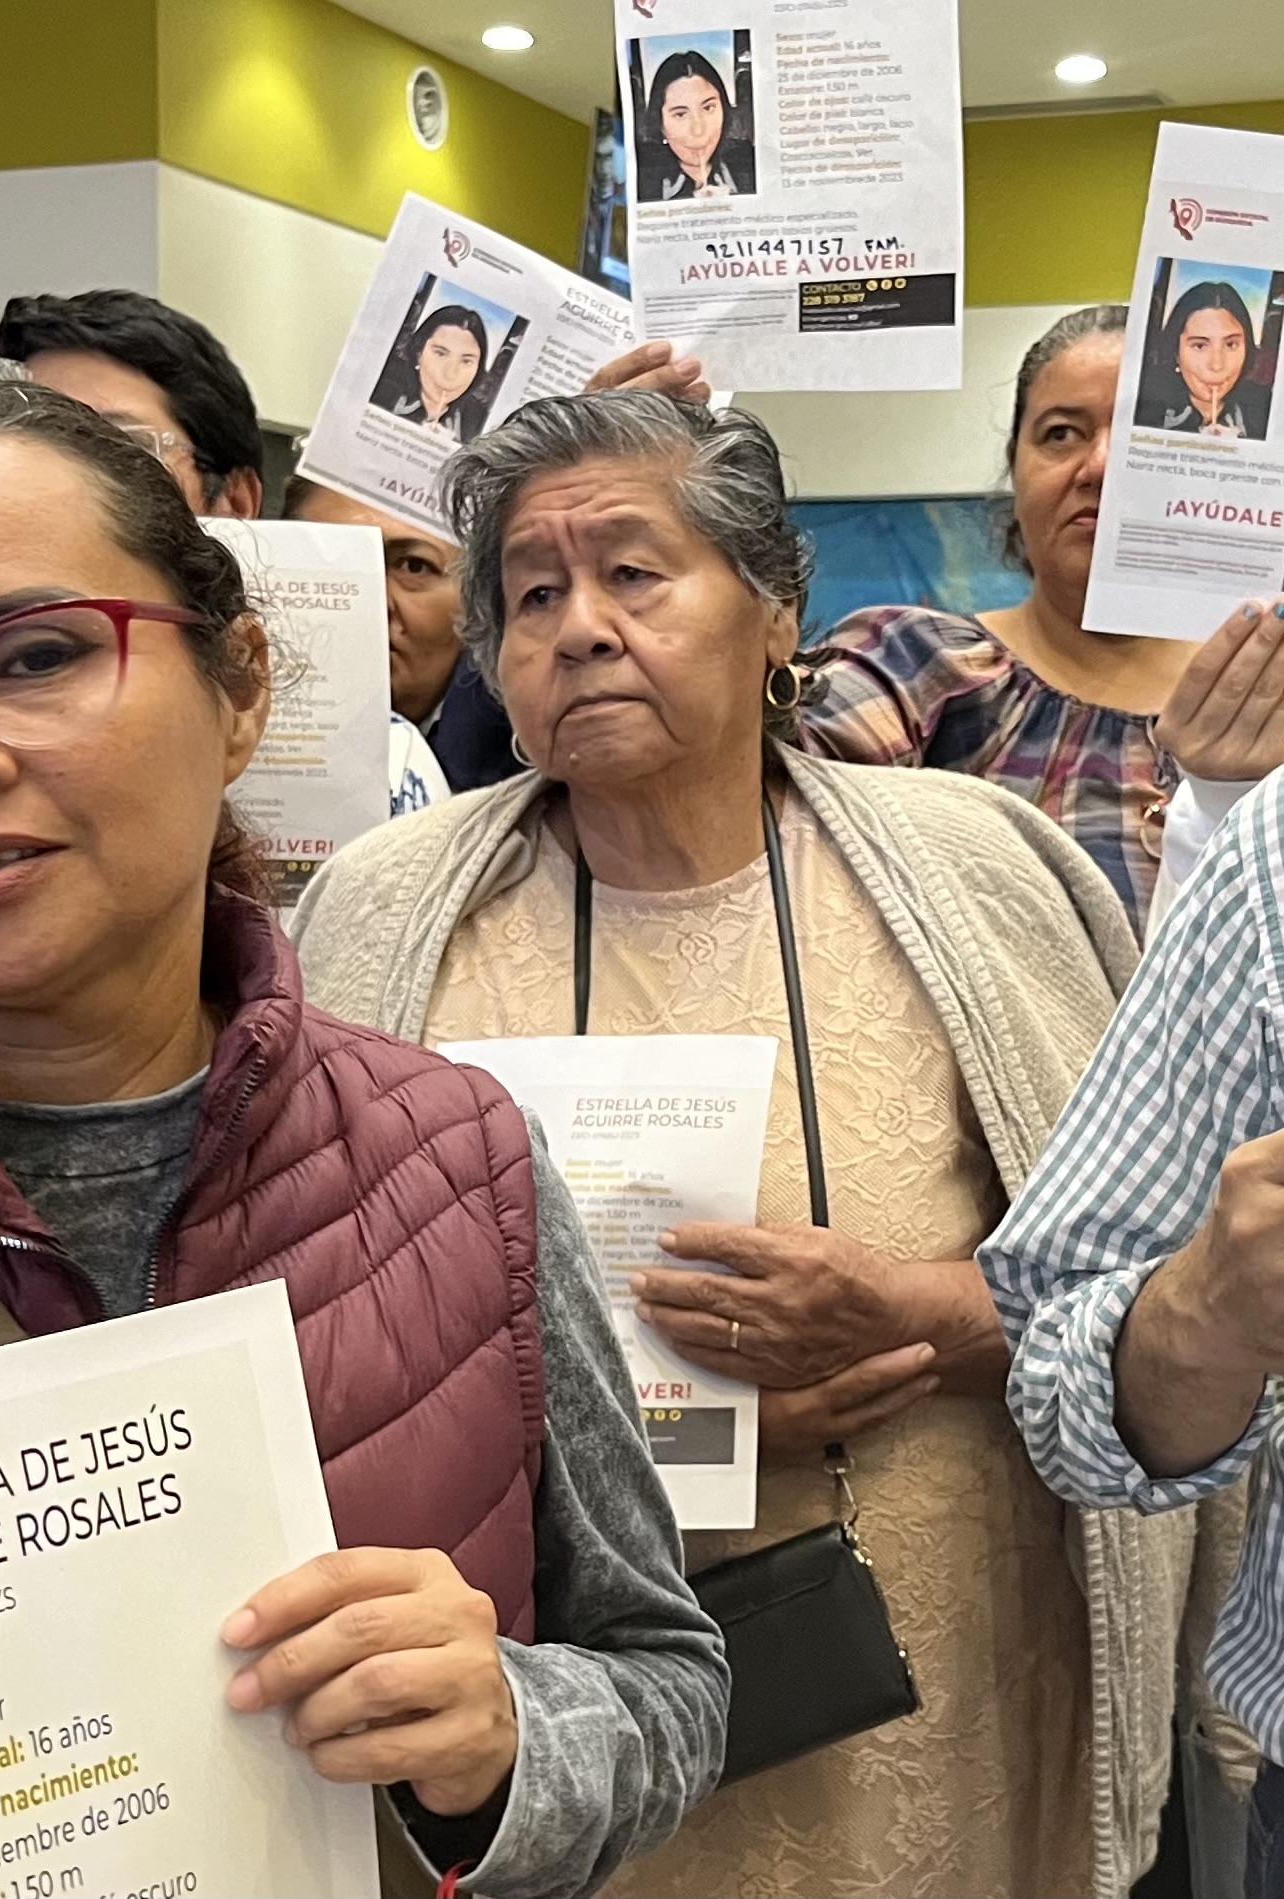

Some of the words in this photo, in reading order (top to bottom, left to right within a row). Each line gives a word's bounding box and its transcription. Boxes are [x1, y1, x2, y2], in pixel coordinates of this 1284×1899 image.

[679, 259, 788, 285] ¡AYÚDALE
[796, 258, 812, 275] A
[818, 252, 916, 274] VOLVER!
[1165, 499, 1284, 528] ¡AYÚDALE
[571, 1113, 644, 1128] AGUIRRE
[647, 1113, 724, 1130] ROSALES
[575, 1097, 653, 1112] ESTRELLA
[657, 1097, 681, 1111] DE
[683, 1098, 737, 1113] JESÚS
[20, 1438, 76, 1492] DE
[80, 1403, 192, 1475] JESÚS
[15, 1473, 182, 1557] ROSALES
[28, 1726, 53, 1758] 16
[58, 1713, 113, 1749] años
[0, 1752, 139, 1817] nacimiento:
[81, 1805, 110, 1836] de
[113, 1782, 170, 1826] 2006
